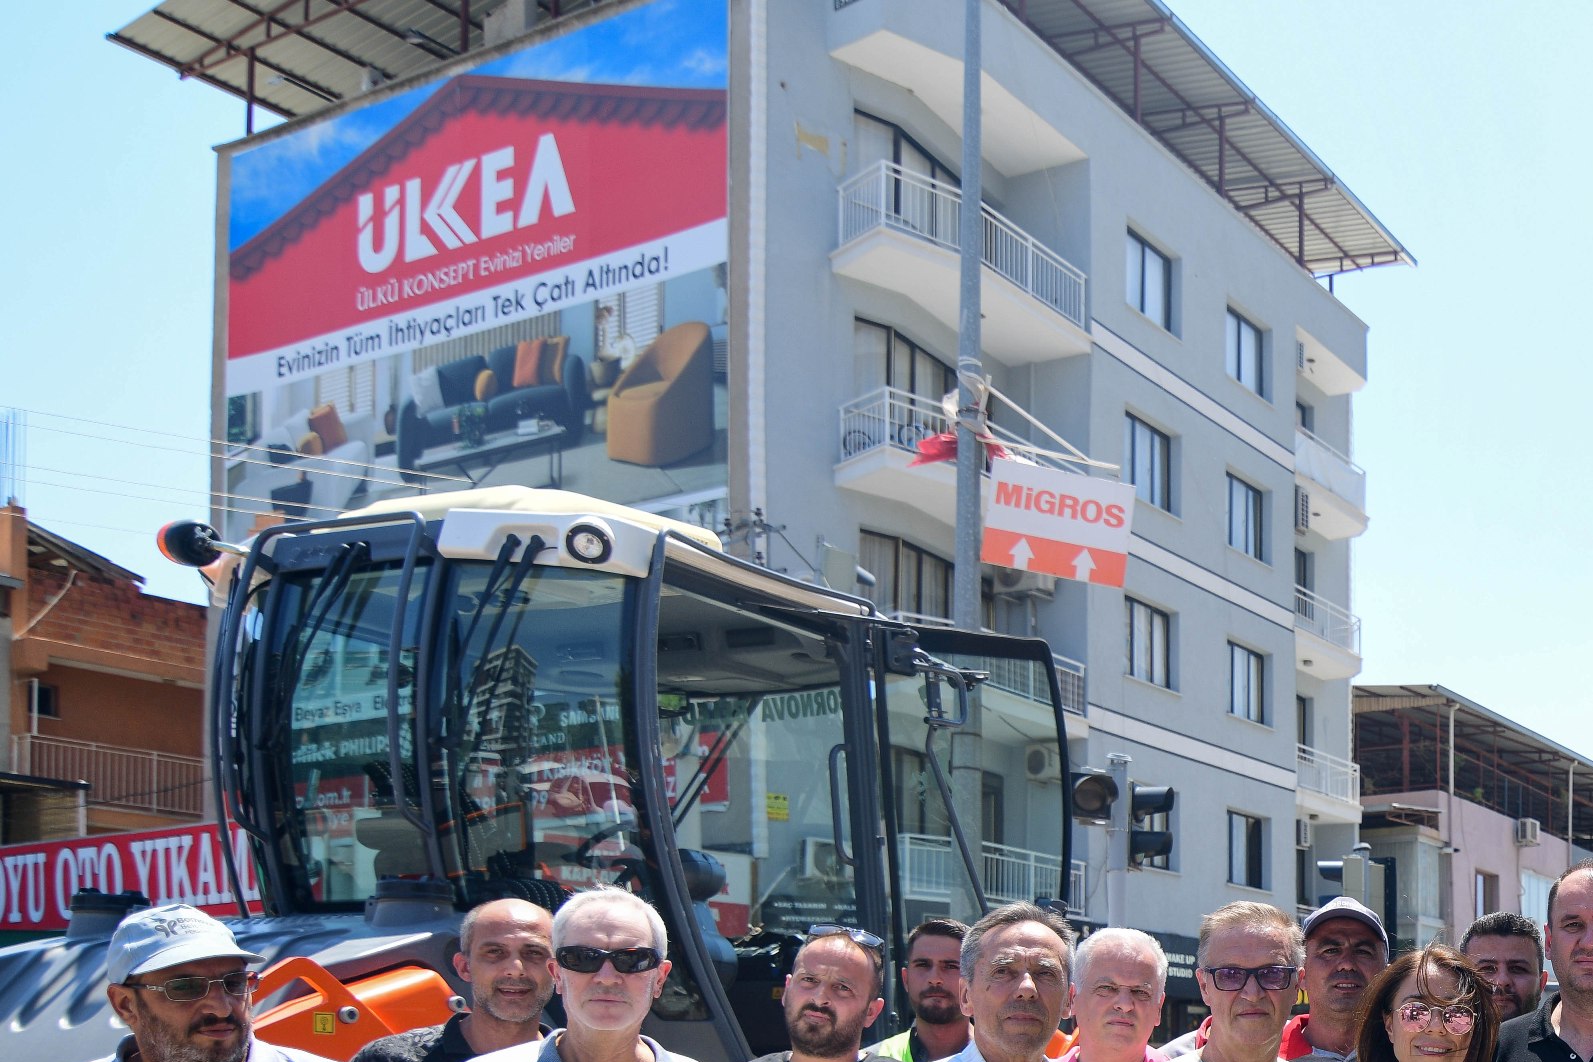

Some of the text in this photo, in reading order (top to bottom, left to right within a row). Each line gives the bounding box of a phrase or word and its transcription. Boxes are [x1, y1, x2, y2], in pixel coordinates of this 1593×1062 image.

[277, 245, 670, 378] Evinizin Tüm İhtiyaçları Tek Çatı Altında!
[355, 233, 576, 312] ÜLKÜ KONSEPT Evinizi Yeniler
